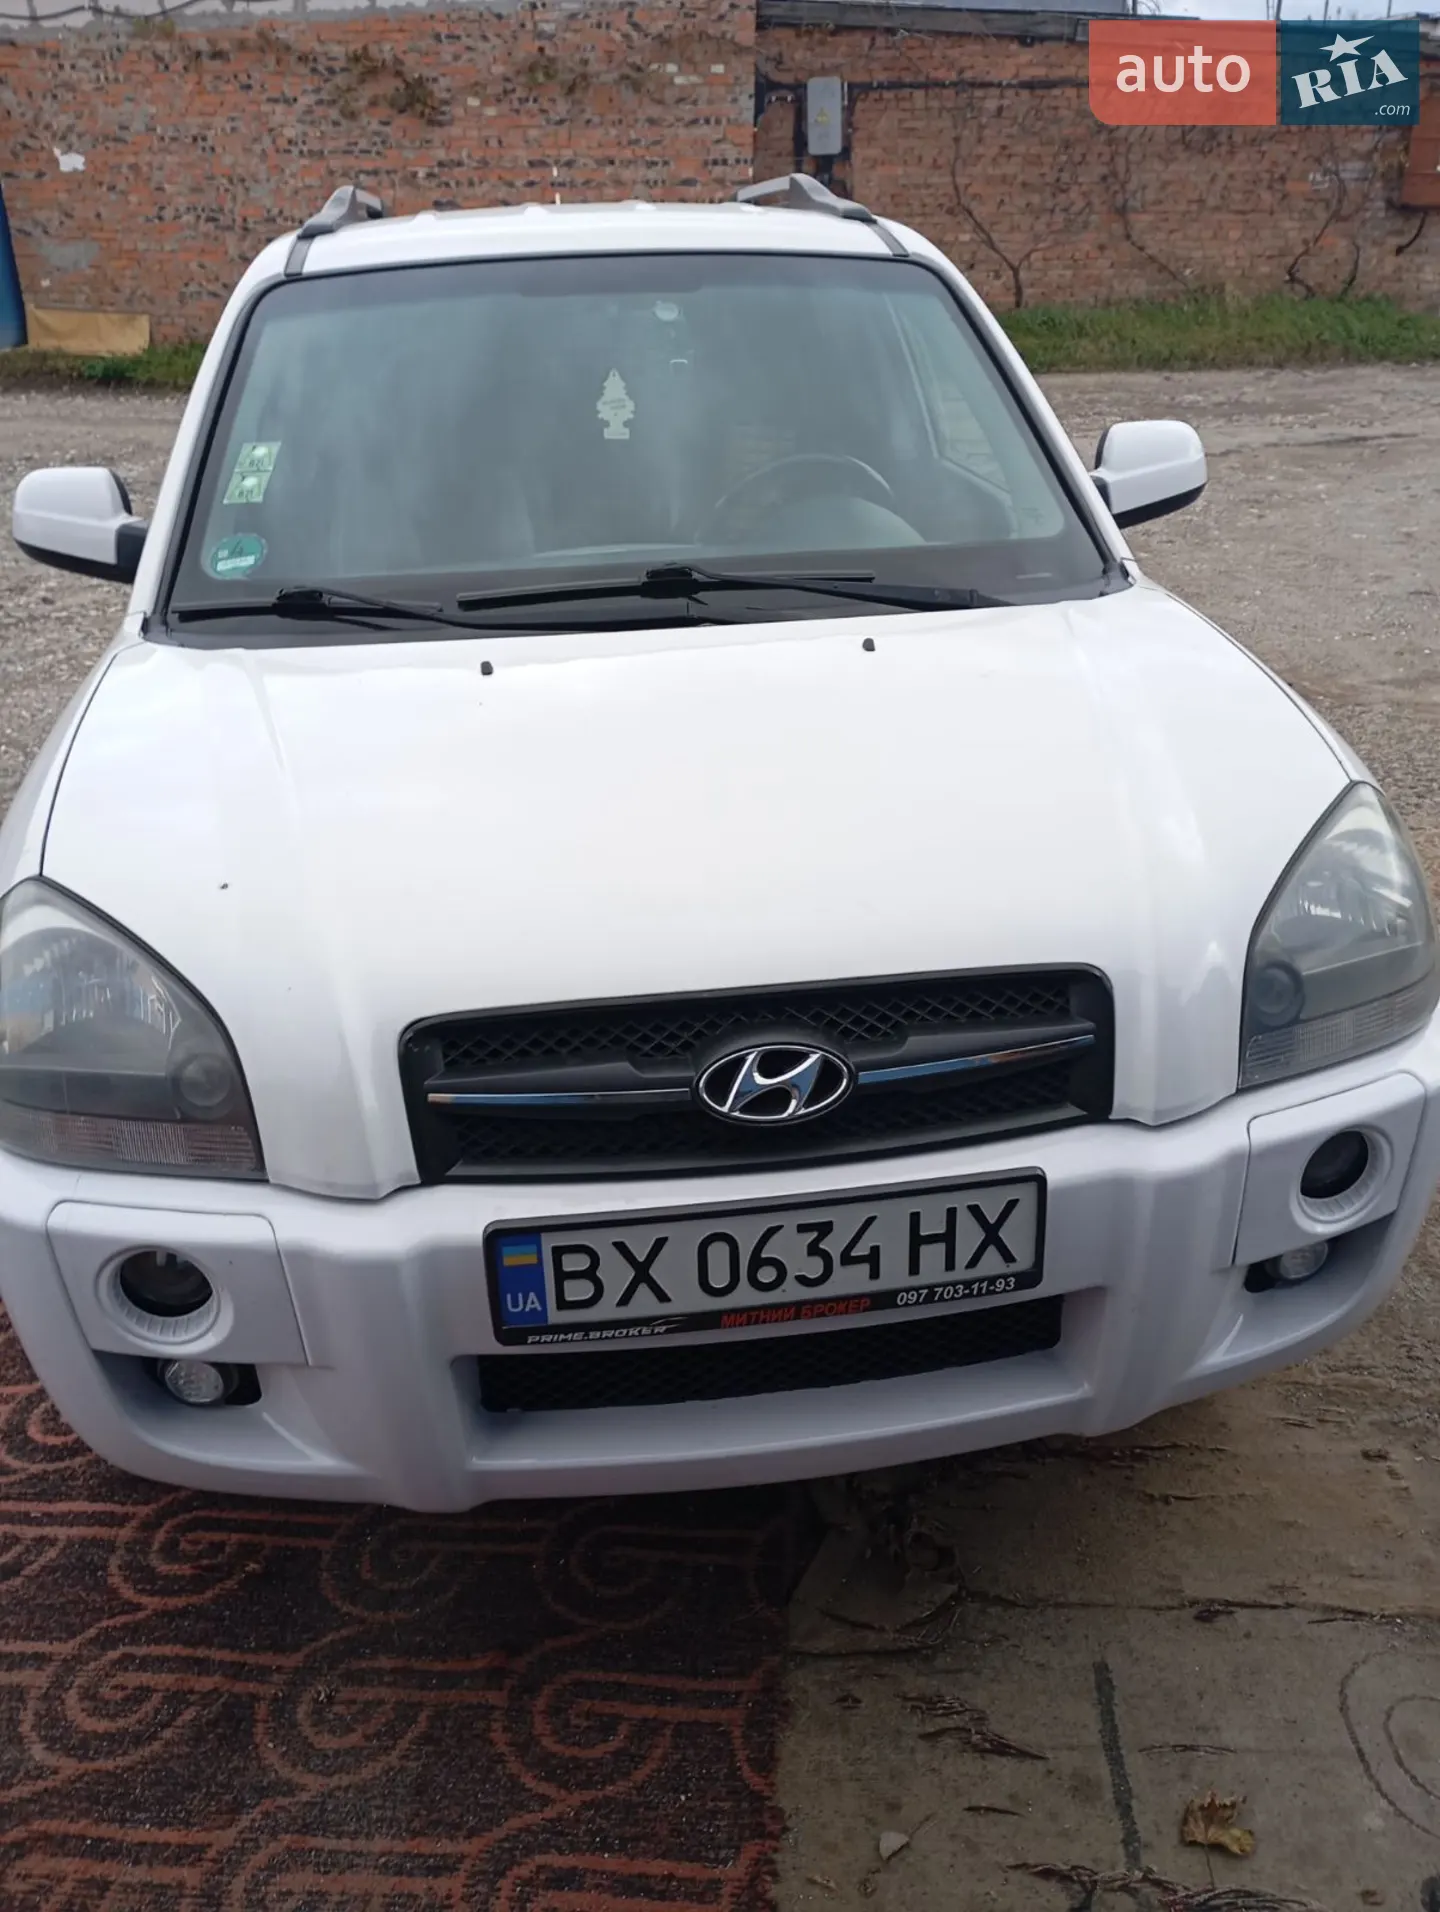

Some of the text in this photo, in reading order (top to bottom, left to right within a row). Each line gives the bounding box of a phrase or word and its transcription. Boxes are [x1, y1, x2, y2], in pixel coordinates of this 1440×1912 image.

[699, 1215, 881, 1297] 0634
[506, 1292, 543, 1313] UA
[896, 1277, 1016, 1306] 097 703-11-93
[801, 1298, 871, 1320] БРОКЕР
